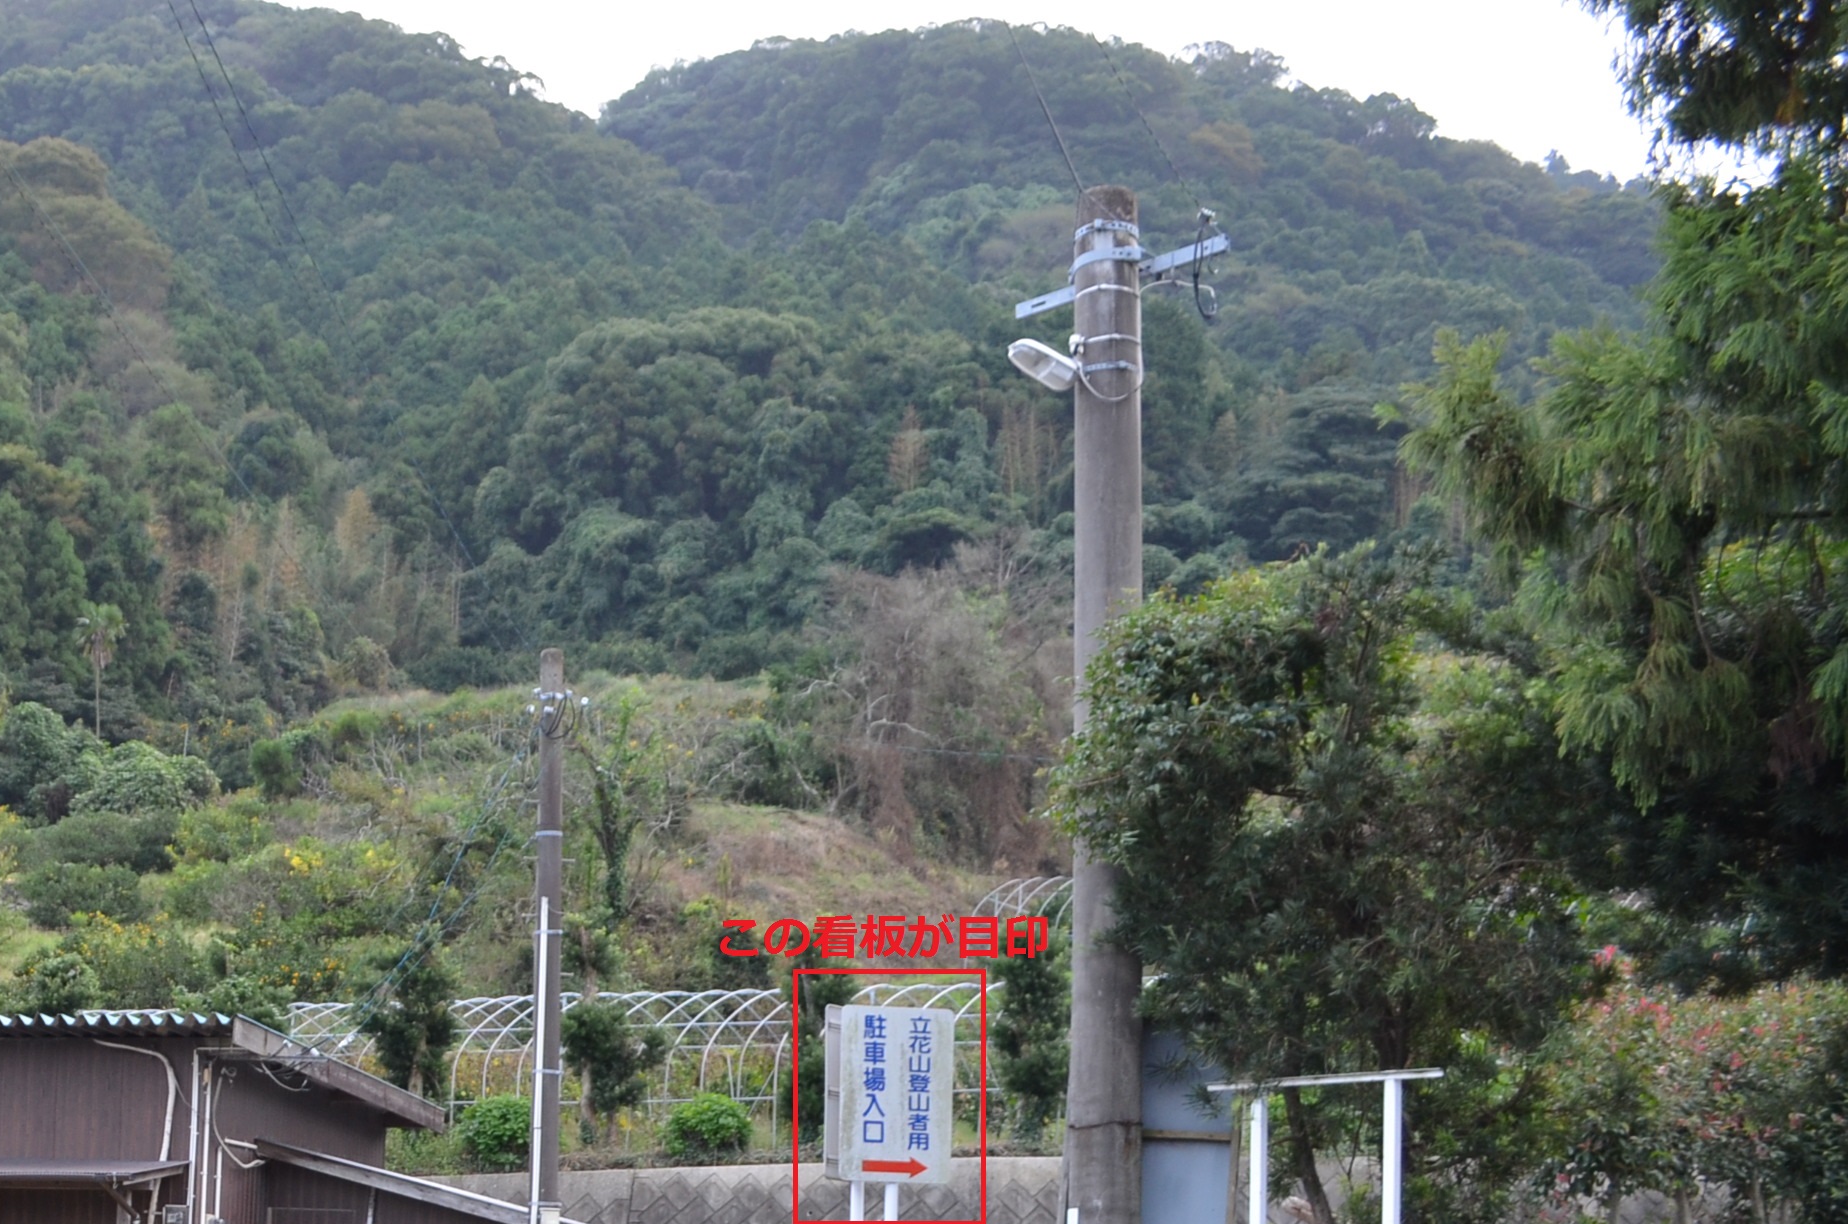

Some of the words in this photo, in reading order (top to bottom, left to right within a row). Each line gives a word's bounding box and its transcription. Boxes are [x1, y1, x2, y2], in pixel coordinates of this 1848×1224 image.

[861, 1013, 888, 1145] 駐車場入口
[907, 1014, 932, 1151] 立花山登山者用
